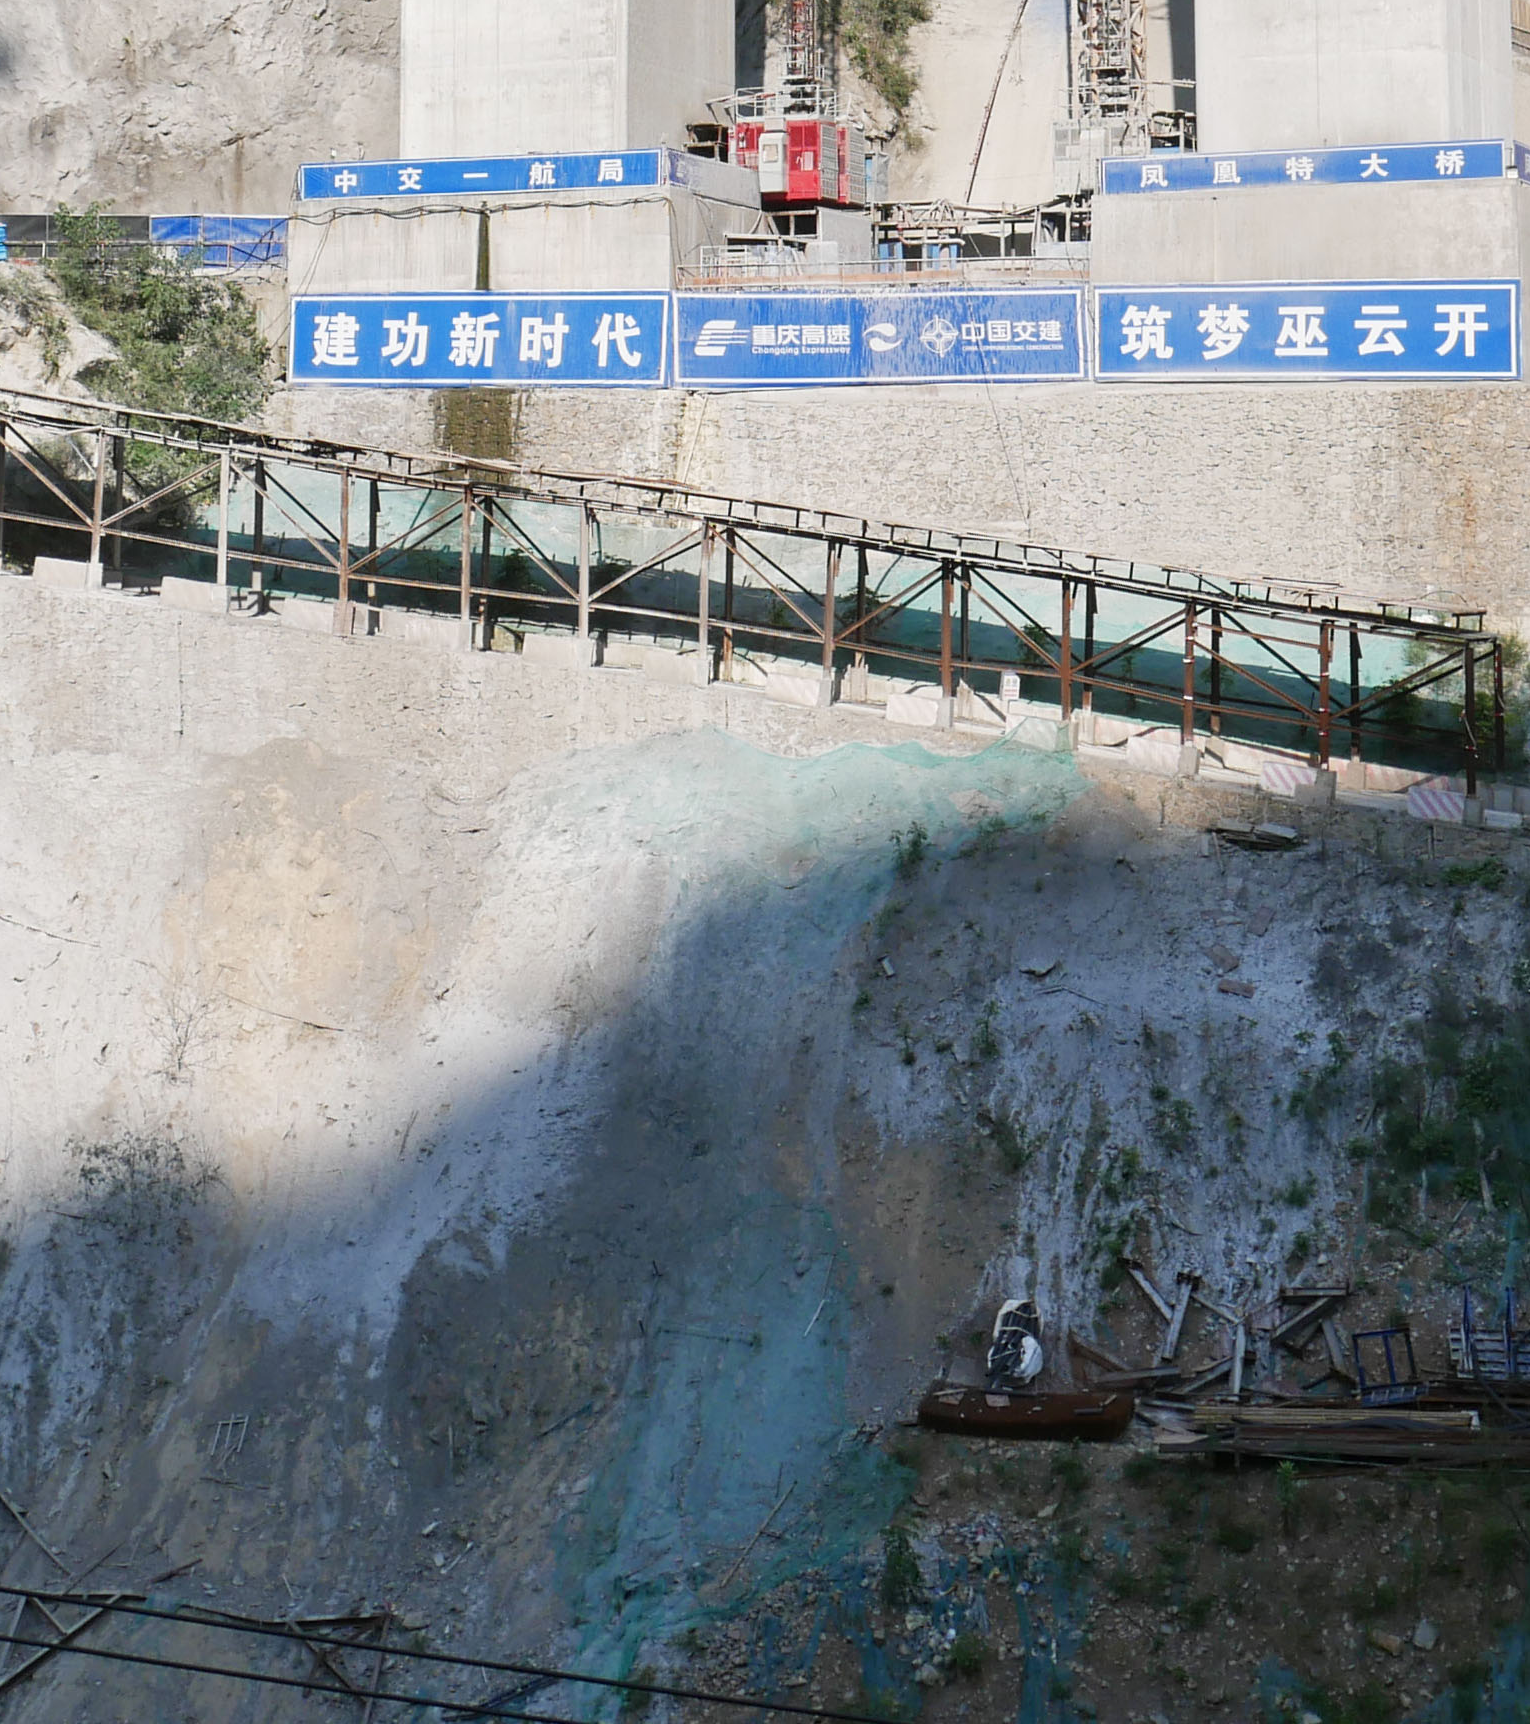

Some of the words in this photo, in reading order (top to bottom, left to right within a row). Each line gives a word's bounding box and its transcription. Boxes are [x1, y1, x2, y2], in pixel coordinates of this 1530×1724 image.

[333, 158, 624, 194] 中交一航局
[1139, 149, 1466, 189] 凤凰特大桥
[311, 311, 643, 368] 建功新时代
[751, 323, 851, 346] 重庆高速
[961, 319, 1063, 343] 中国交建
[1119, 303, 1490, 361] 筑梦巫云开
